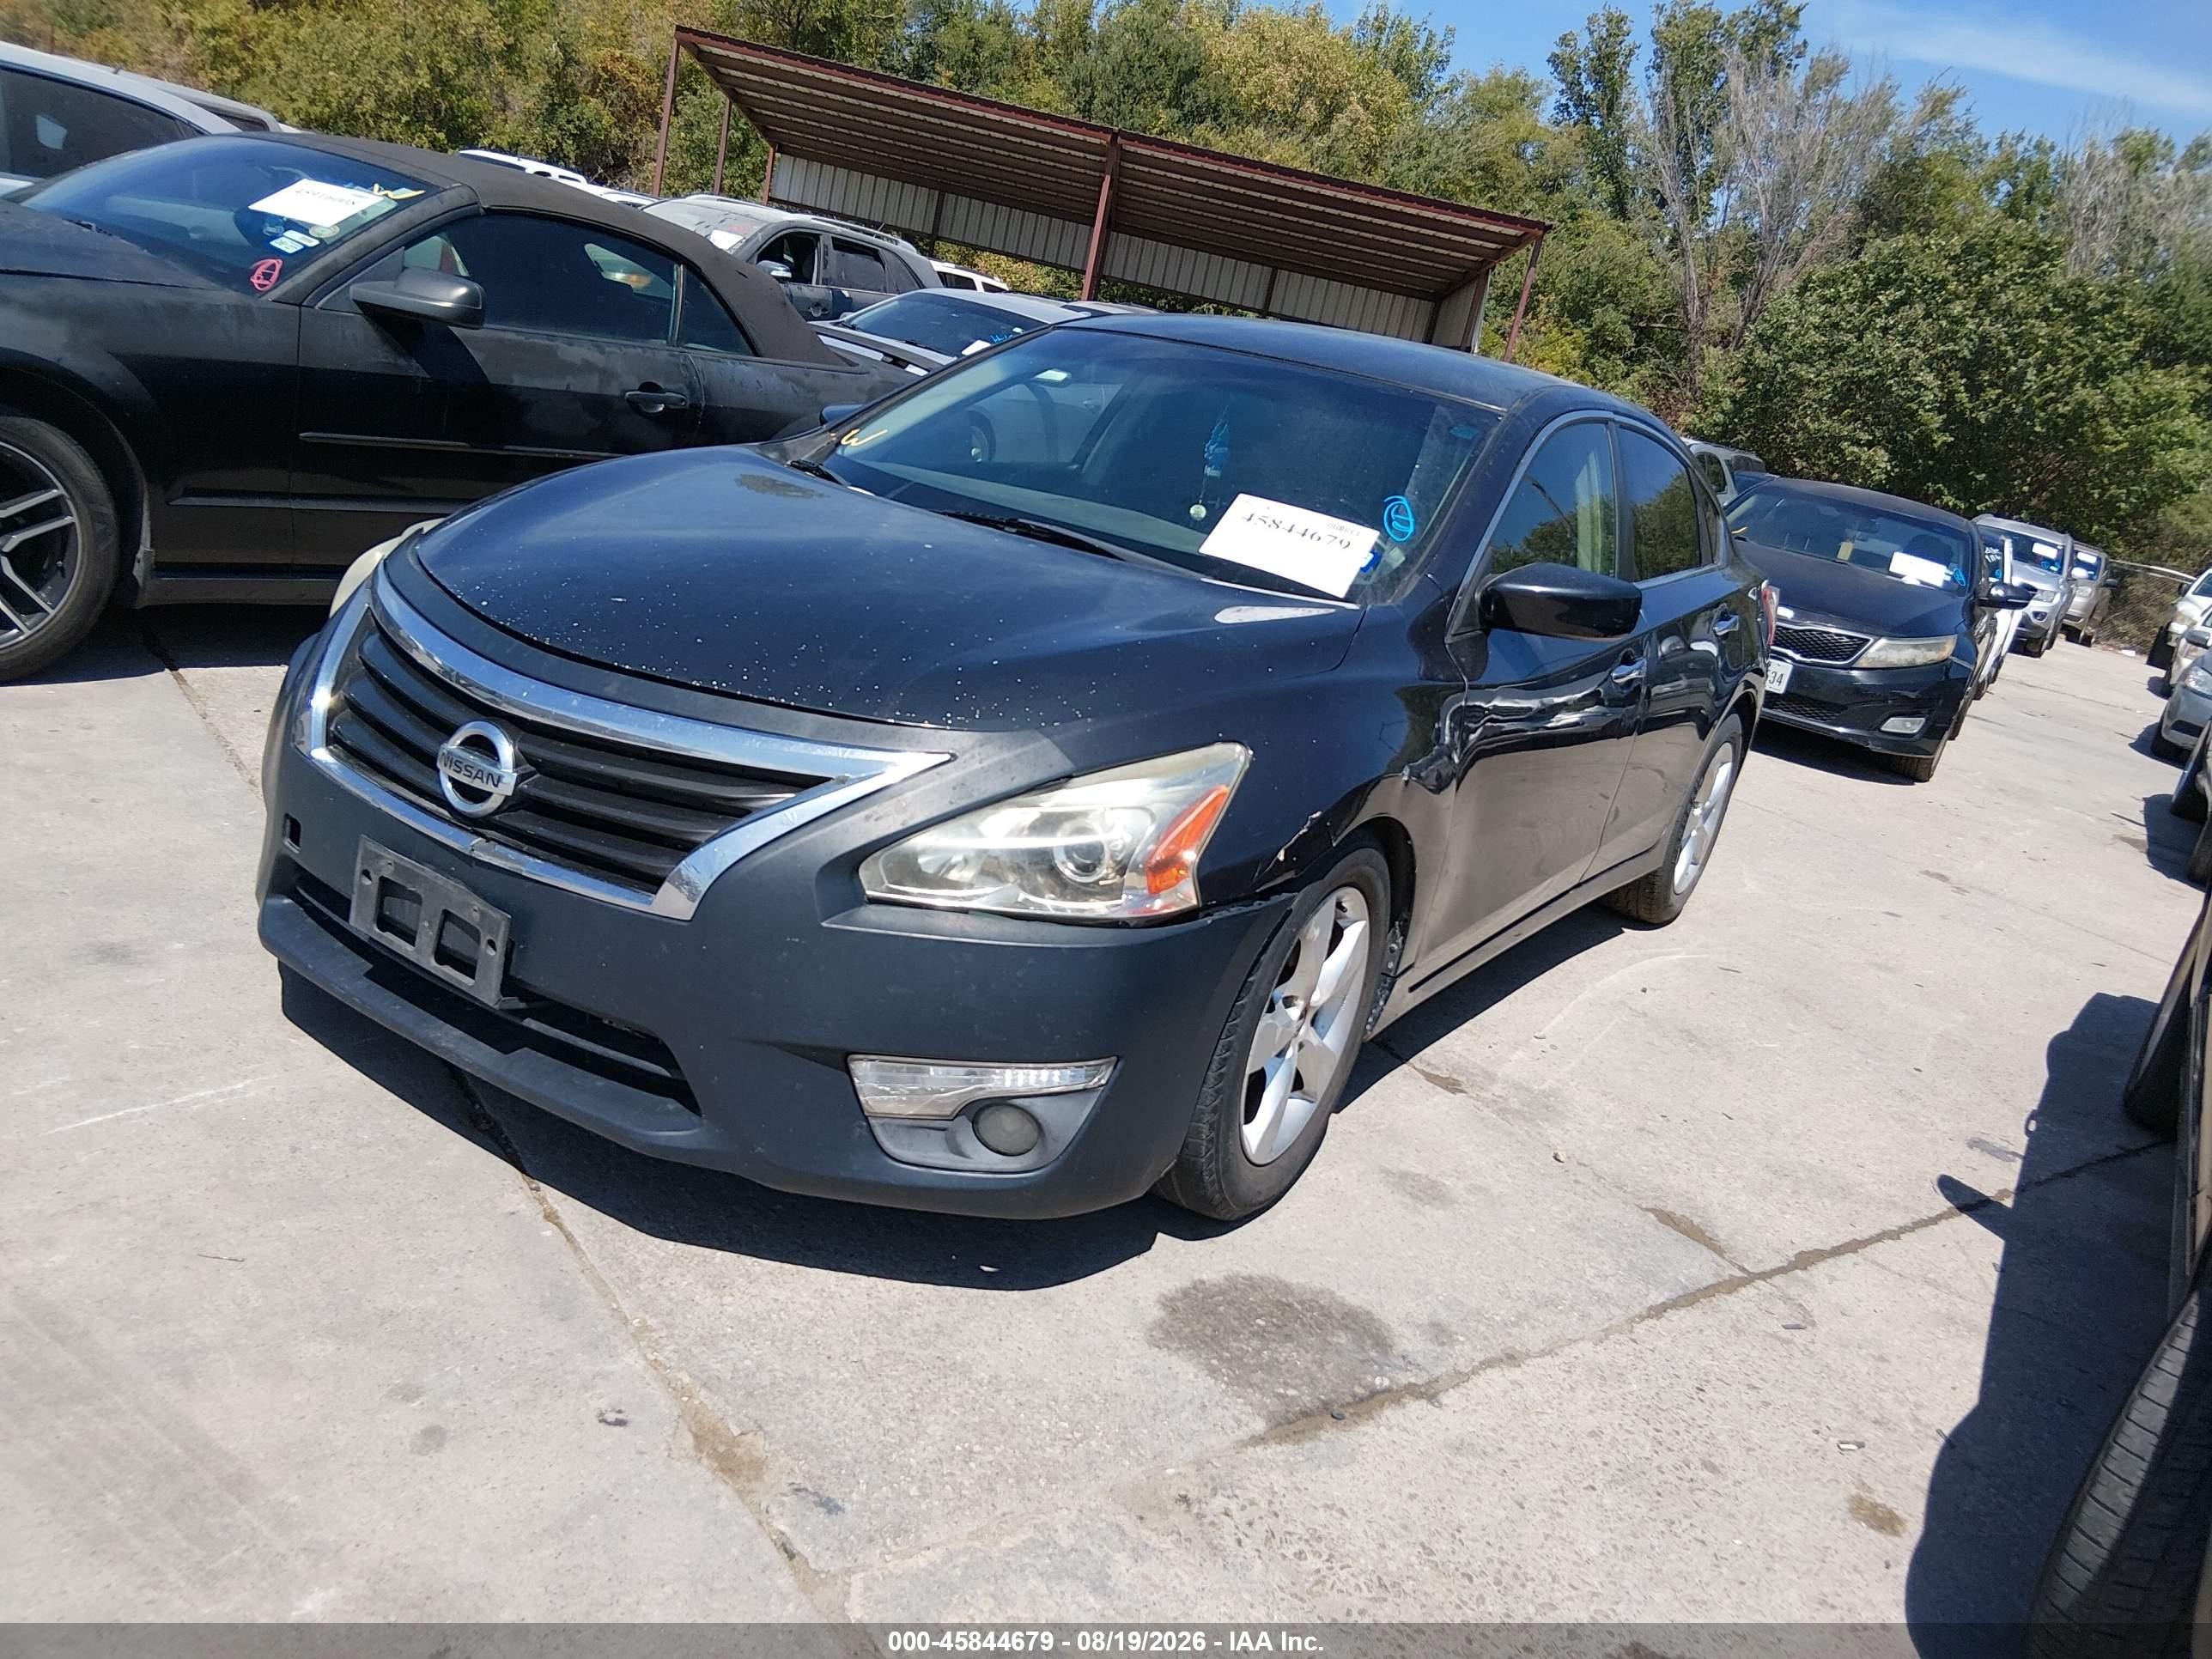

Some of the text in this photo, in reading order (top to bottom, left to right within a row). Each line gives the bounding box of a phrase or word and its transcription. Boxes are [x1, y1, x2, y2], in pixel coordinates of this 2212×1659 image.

[1242, 513, 1352, 549] 45844679
[1766, 670, 1784, 686] 34
[441, 750, 501, 787] NISSAN
